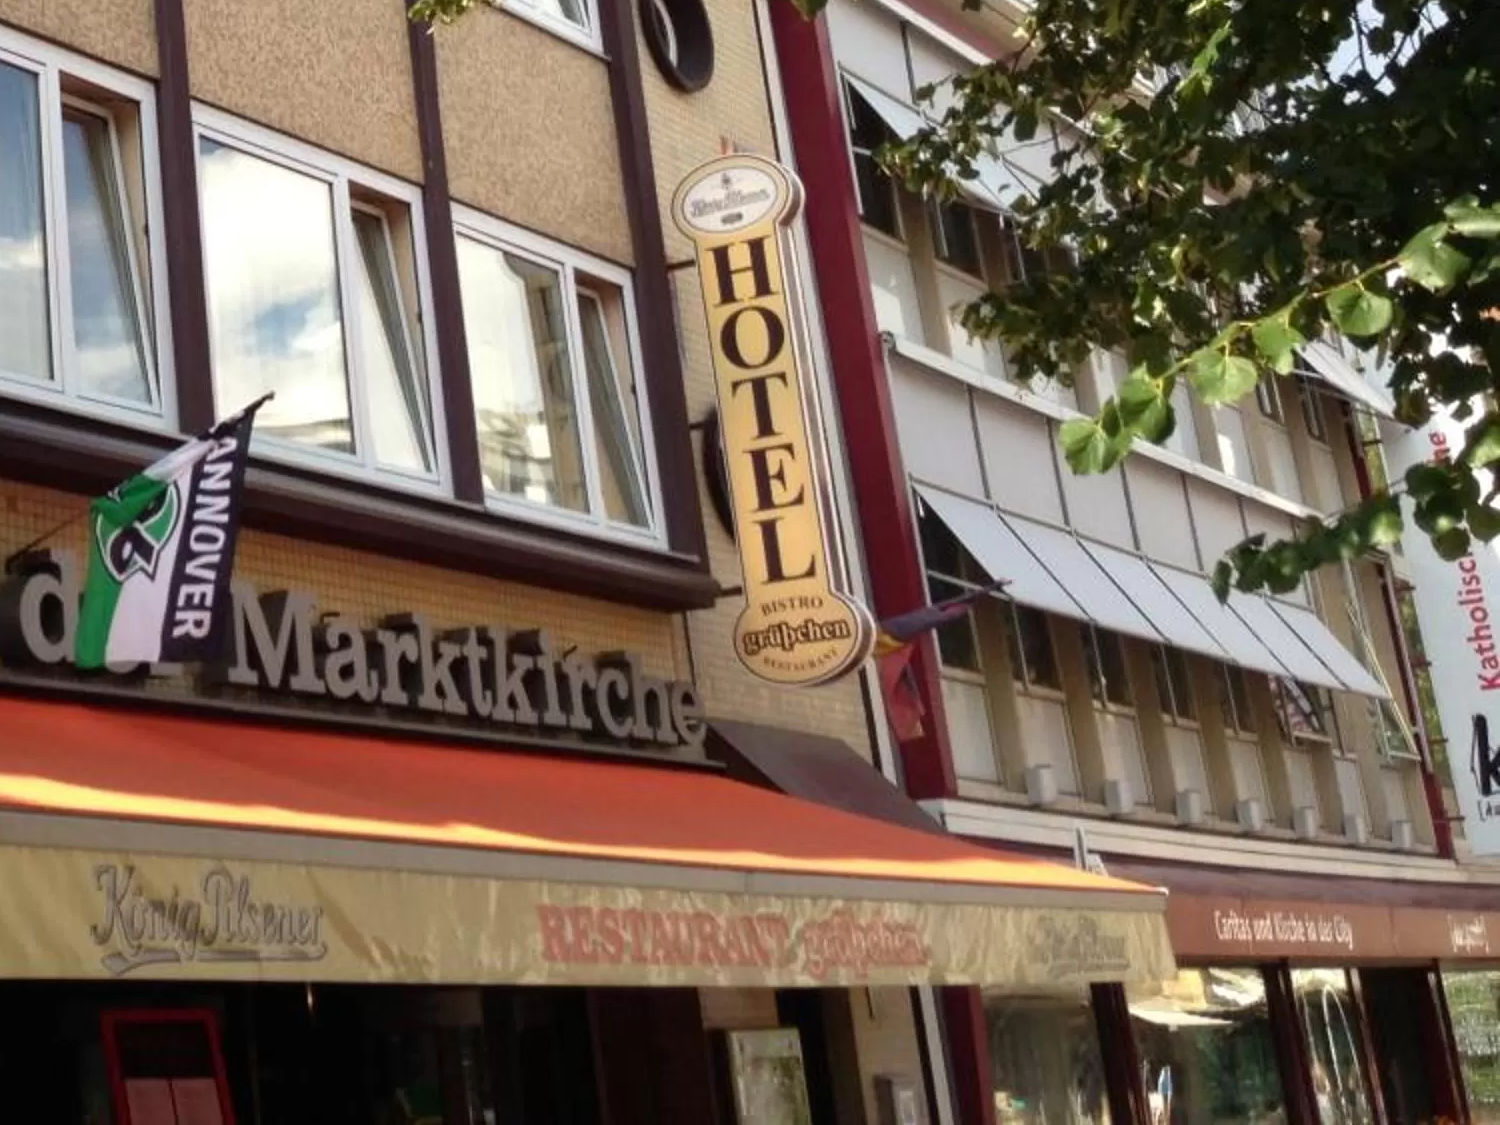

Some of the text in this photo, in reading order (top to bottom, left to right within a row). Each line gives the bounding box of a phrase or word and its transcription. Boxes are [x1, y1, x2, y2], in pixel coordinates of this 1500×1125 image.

[705, 234, 818, 587] HOTEL
[171, 429, 239, 640] ANNOVER
[228, 581, 708, 749] Marktkirche
[761, 595, 824, 617] BISTRO
[762, 647, 838, 672] RESTAURANT
[1457, 551, 1500, 692] Katholisc
[537, 903, 798, 968] RESTAURANT
